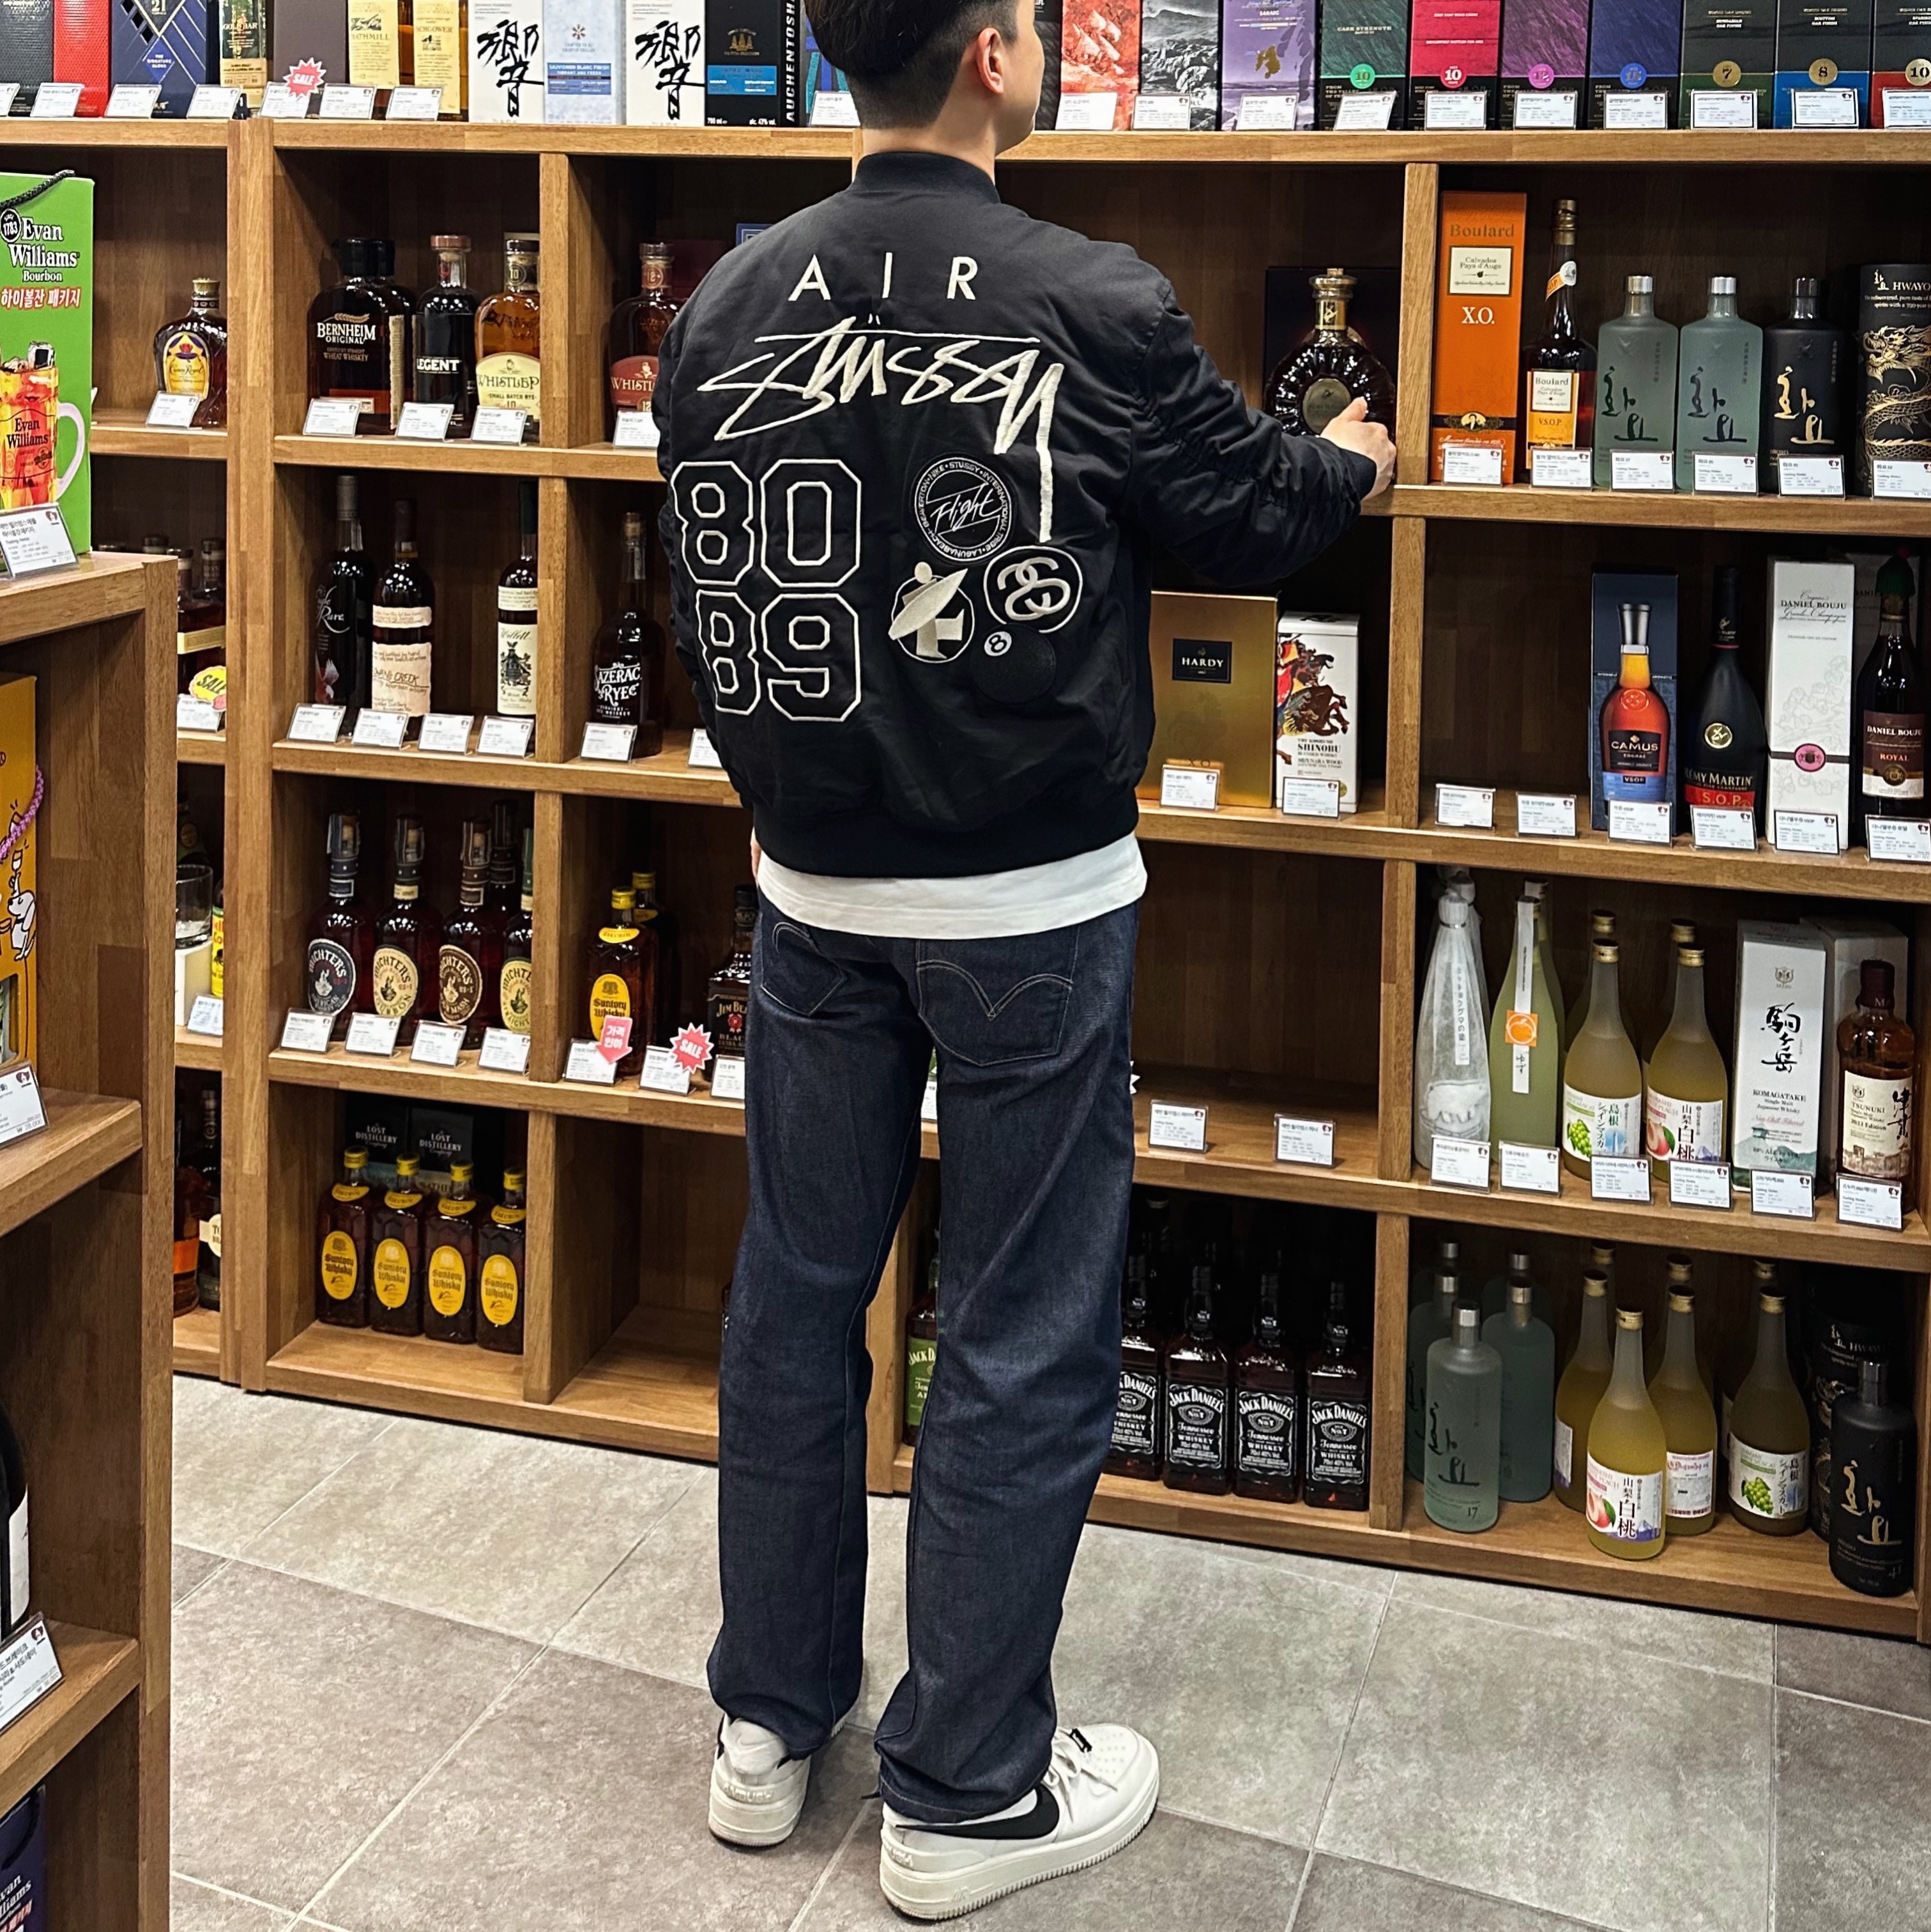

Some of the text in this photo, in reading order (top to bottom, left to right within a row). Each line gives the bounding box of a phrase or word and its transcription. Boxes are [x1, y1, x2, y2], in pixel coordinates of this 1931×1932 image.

[1355, 71, 1371, 80] 10
[1445, 70, 1462, 80] 10
[1722, 68, 1732, 79] 7
[1819, 66, 1828, 77] 8
[1910, 67, 1930, 78] 10
[292, 73, 315, 87] SALE
[2, 223, 19, 236] 1783
[21, 217, 63, 241] Evan
[1450, 223, 1515, 238] Boulard
[8, 243, 78, 268] Williams
[22, 271, 63, 282] Bourbon
[788, 252, 978, 301] AIR
[1893, 282, 1931, 291] HWAYO
[1, 288, 82, 309] 하이볼잔 패키지
[1462, 307, 1495, 325] X.O.
[317, 323, 376, 341] BERNHEIM
[326, 335, 364, 344] ORIGINAL
[343, 353, 369, 362] WHISKEY
[416, 359, 459, 371] LEGENT
[1535, 377, 1569, 386] Boulard
[15, 418, 40, 433] Evan
[7, 433, 49, 448] Williams
[927, 464, 945, 480] NIKE
[949, 461, 981, 471] STUSSY
[982, 471, 1009, 532] INTERNATIONAL
[930, 484, 1002, 533] Flight
[671, 459, 862, 588] 80
[501, 627, 531, 640] Willett
[989, 634, 1007, 653] 8
[696, 589, 862, 722] 89
[1182, 657, 1224, 668] HARDY
[1867, 725, 1922, 735] DANIEL BOUJU
[1297, 744, 1341, 753] SHINOBU
[1611, 741, 1658, 751] CAMUS
[1879, 753, 1909, 762] ROYAL
[1709, 772, 1752, 786] MARTIN
[309, 949, 347, 978] MICHTER'S
[375, 956, 411, 983] MICHTER'S
[593, 997, 627, 1011] Suntory
[717, 1003, 732, 1017] JIM
[606, 1025, 625, 1036] 가격
[679, 1039, 703, 1059] SALE
[1753, 1089, 1806, 1102] KOMAGATAKE
[1852, 1101, 1885, 1114] TSUNUKI
[1608, 1103, 1619, 1126] 島根
[367, 1125, 386, 1134] LOST
[355, 1131, 397, 1145] DISTILLERY
[431, 1133, 450, 1142] LOST
[419, 1139, 462, 1151] DISTILLERY
[325, 1254, 354, 1266] Suntory
[326, 1263, 353, 1277] Whisky
[377, 1261, 407, 1273] Suntory
[378, 1271, 406, 1284] Whisky
[432, 1269, 462, 1282] Suntory
[432, 1278, 461, 1292] Whisky
[485, 1277, 514, 1290] Suntory
[485, 1287, 514, 1301] Whisky
[908, 1350, 927, 1365] JACK
[1124, 1375, 1157, 1399] DANIEL'S
[1169, 1388, 1225, 1413] JACK DANIEL'S
[1239, 1396, 1294, 1421] JACK DANIEL'S
[1311, 1404, 1368, 1429] JACK DANIEL'S
[1177, 1422, 1214, 1434] Tennessee
[1178, 1434, 1214, 1445] WHISKEY
[1247, 1429, 1285, 1442] Tennessee
[1248, 1442, 1283, 1452] WHISKEY
[1320, 1439, 1357, 1450] Tennessee
[1320, 1451, 1356, 1460] WHISKEY
[1467, 1506, 1478, 1519] 17
